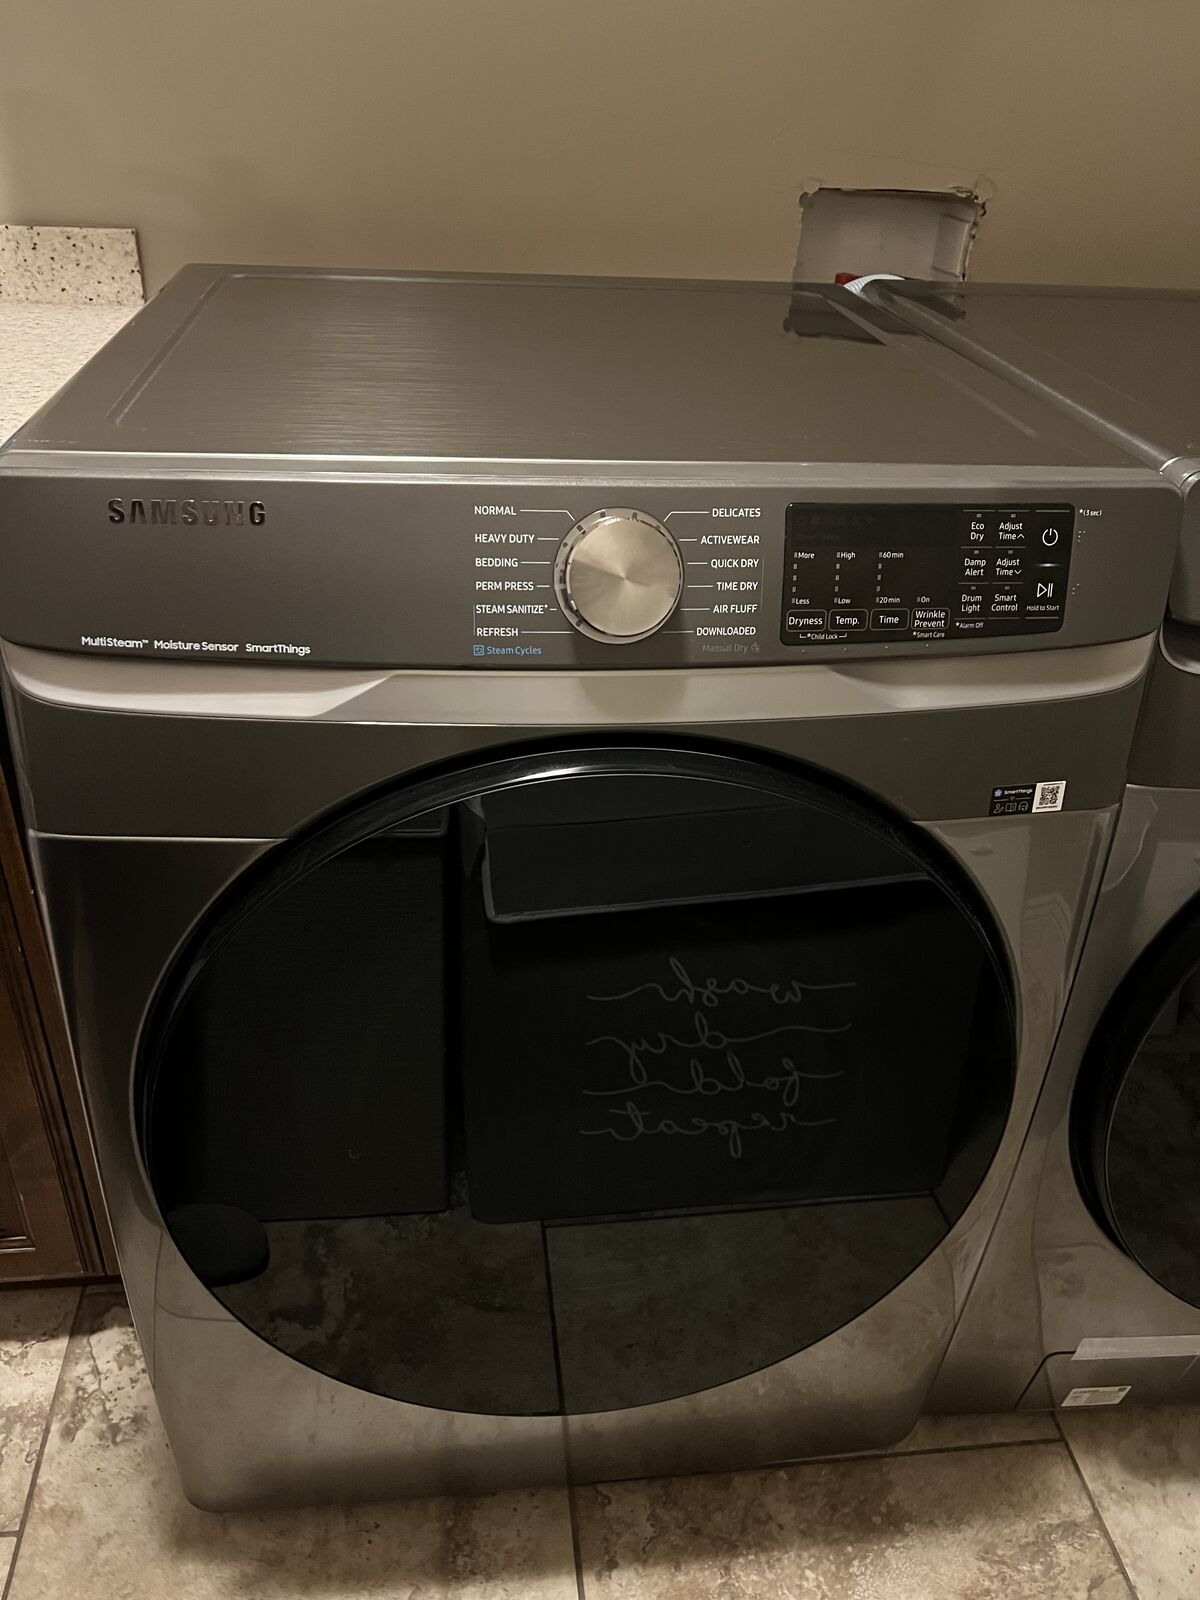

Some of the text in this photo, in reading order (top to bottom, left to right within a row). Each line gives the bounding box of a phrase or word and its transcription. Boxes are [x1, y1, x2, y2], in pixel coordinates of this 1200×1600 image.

[107, 497, 267, 526] SAMSUNG
[474, 505, 517, 516] NORMAL
[712, 508, 761, 518] DELICATES
[971, 522, 985, 530] Eco
[999, 522, 1023, 531] Adjust
[474, 533, 535, 544] HEAVY DUTY
[700, 535, 760, 545] ACTIVEWEAR
[970, 532, 985, 542] Dry
[998, 532, 1017, 540] Time
[840, 552, 856, 560] High
[475, 557, 519, 567] BEDDING
[711, 558, 760, 569] QUICK DRY
[964, 558, 987, 567] Damp
[996, 558, 1020, 567] Adjust
[965, 568, 984, 576] Alert
[996, 568, 1014, 576] Time
[476, 581, 534, 591] PERM PRESS
[716, 581, 759, 591] TIME DRY
[961, 594, 983, 602] Drum
[994, 594, 1017, 602] Smart
[476, 604, 505, 614] STEAM
[712, 604, 758, 613] AIR FLUFF
[961, 603, 981, 613] Light
[991, 603, 1018, 612] Control
[879, 615, 899, 624] Time
[915, 610, 946, 619] Wrinkle
[788, 616, 823, 627] Dryness
[835, 616, 860, 626] Temp.
[914, 619, 945, 628] Prevent
[476, 627, 519, 637] REFRESH
[696, 626, 757, 636] DOWNLOADED
[154, 638, 201, 651] Moisture
[201, 641, 239, 652] Sensor
[245, 643, 311, 656] SmartThings
[486, 646, 542, 656] Steam Cycles
[702, 643, 749, 655] Manual Dry
